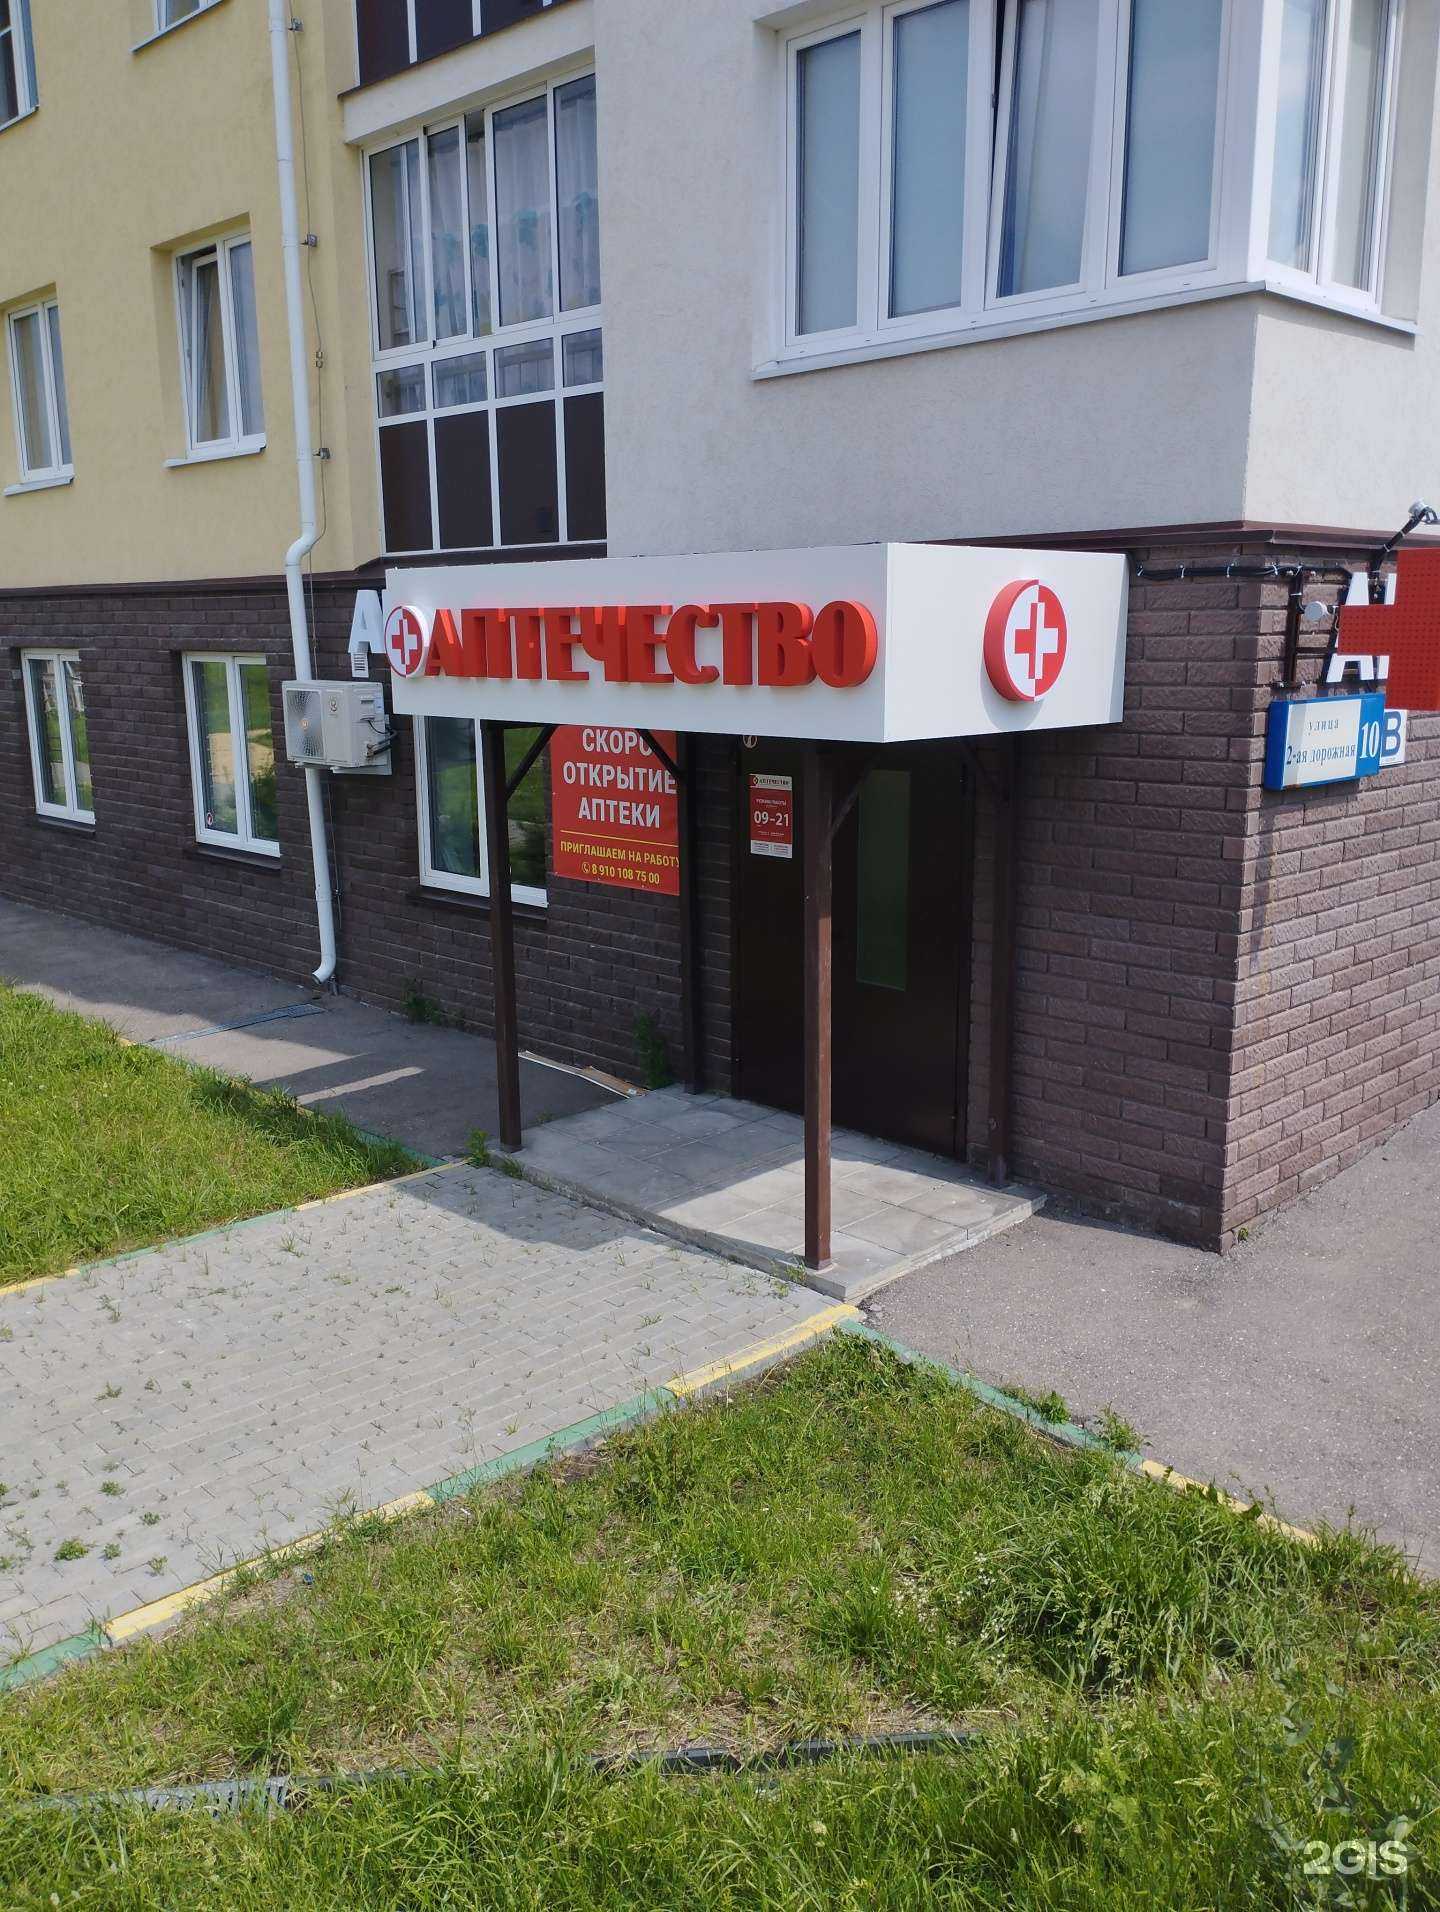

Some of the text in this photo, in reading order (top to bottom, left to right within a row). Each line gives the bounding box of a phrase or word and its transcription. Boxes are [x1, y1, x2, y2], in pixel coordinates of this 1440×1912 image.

[347, 589, 386, 654] А
[424, 600, 878, 688] АПТЕЧЕСТВО
[1307, 719, 1339, 736] улица
[1360, 720, 1380, 759] 10
[1380, 710, 1401, 758] В
[1285, 745, 1308, 766] 2-ая
[563, 761, 678, 795] ОТКРЫТИЕ
[578, 797, 660, 828] АПТЕКИ
[753, 810, 789, 827] 09-21
[560, 841, 626, 860] ПРИГЛАШАЕМ
[628, 850, 642, 863] НА
[591, 863, 660, 884] 8 910 108 75 00
